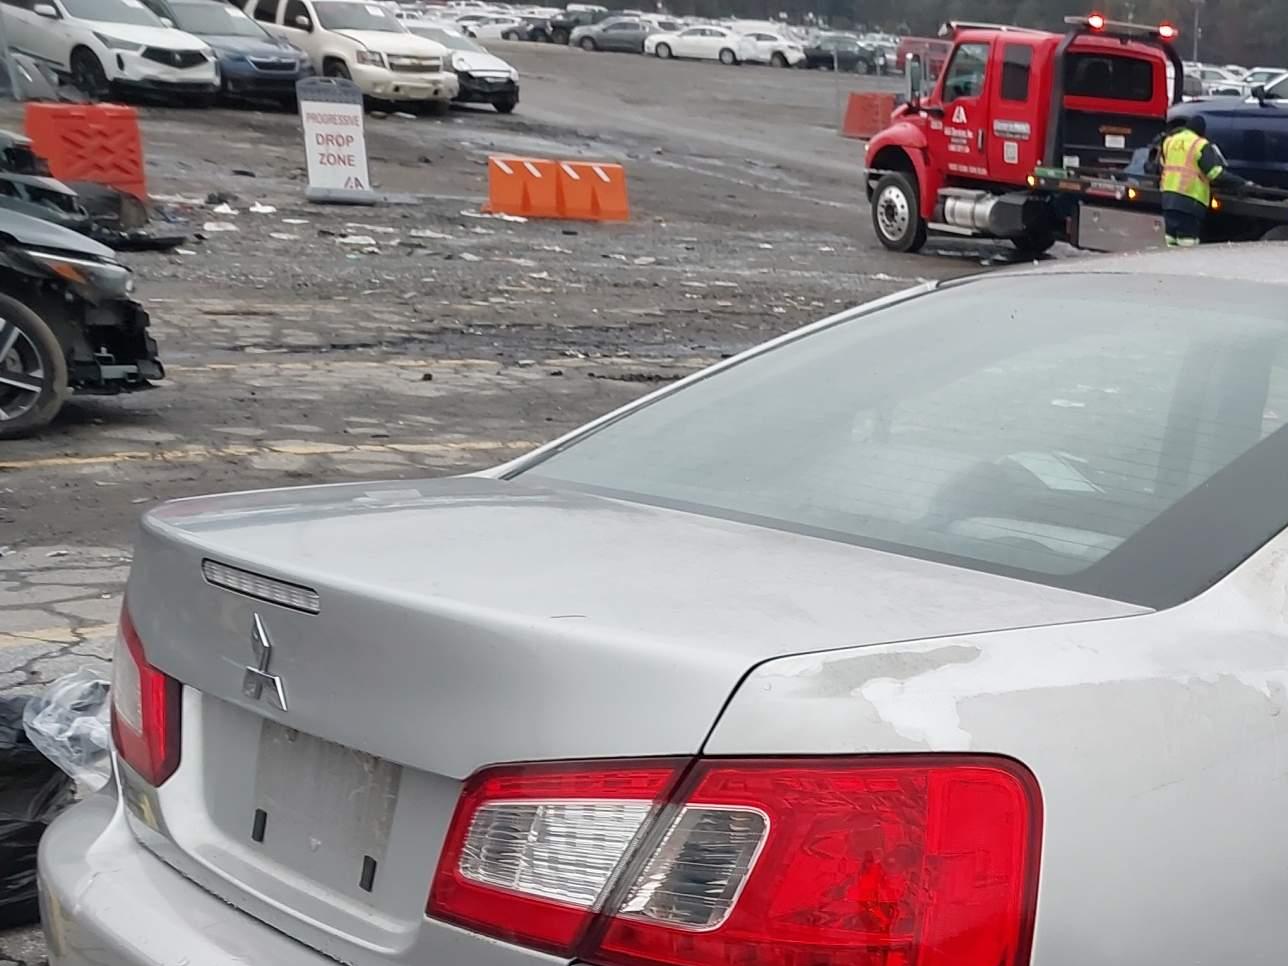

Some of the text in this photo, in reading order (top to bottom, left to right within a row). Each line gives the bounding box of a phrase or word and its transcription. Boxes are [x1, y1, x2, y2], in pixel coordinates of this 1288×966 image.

[306, 112, 360, 127] PROGRESSIVE
[315, 133, 354, 147] DROP
[318, 152, 356, 167] ZONE
